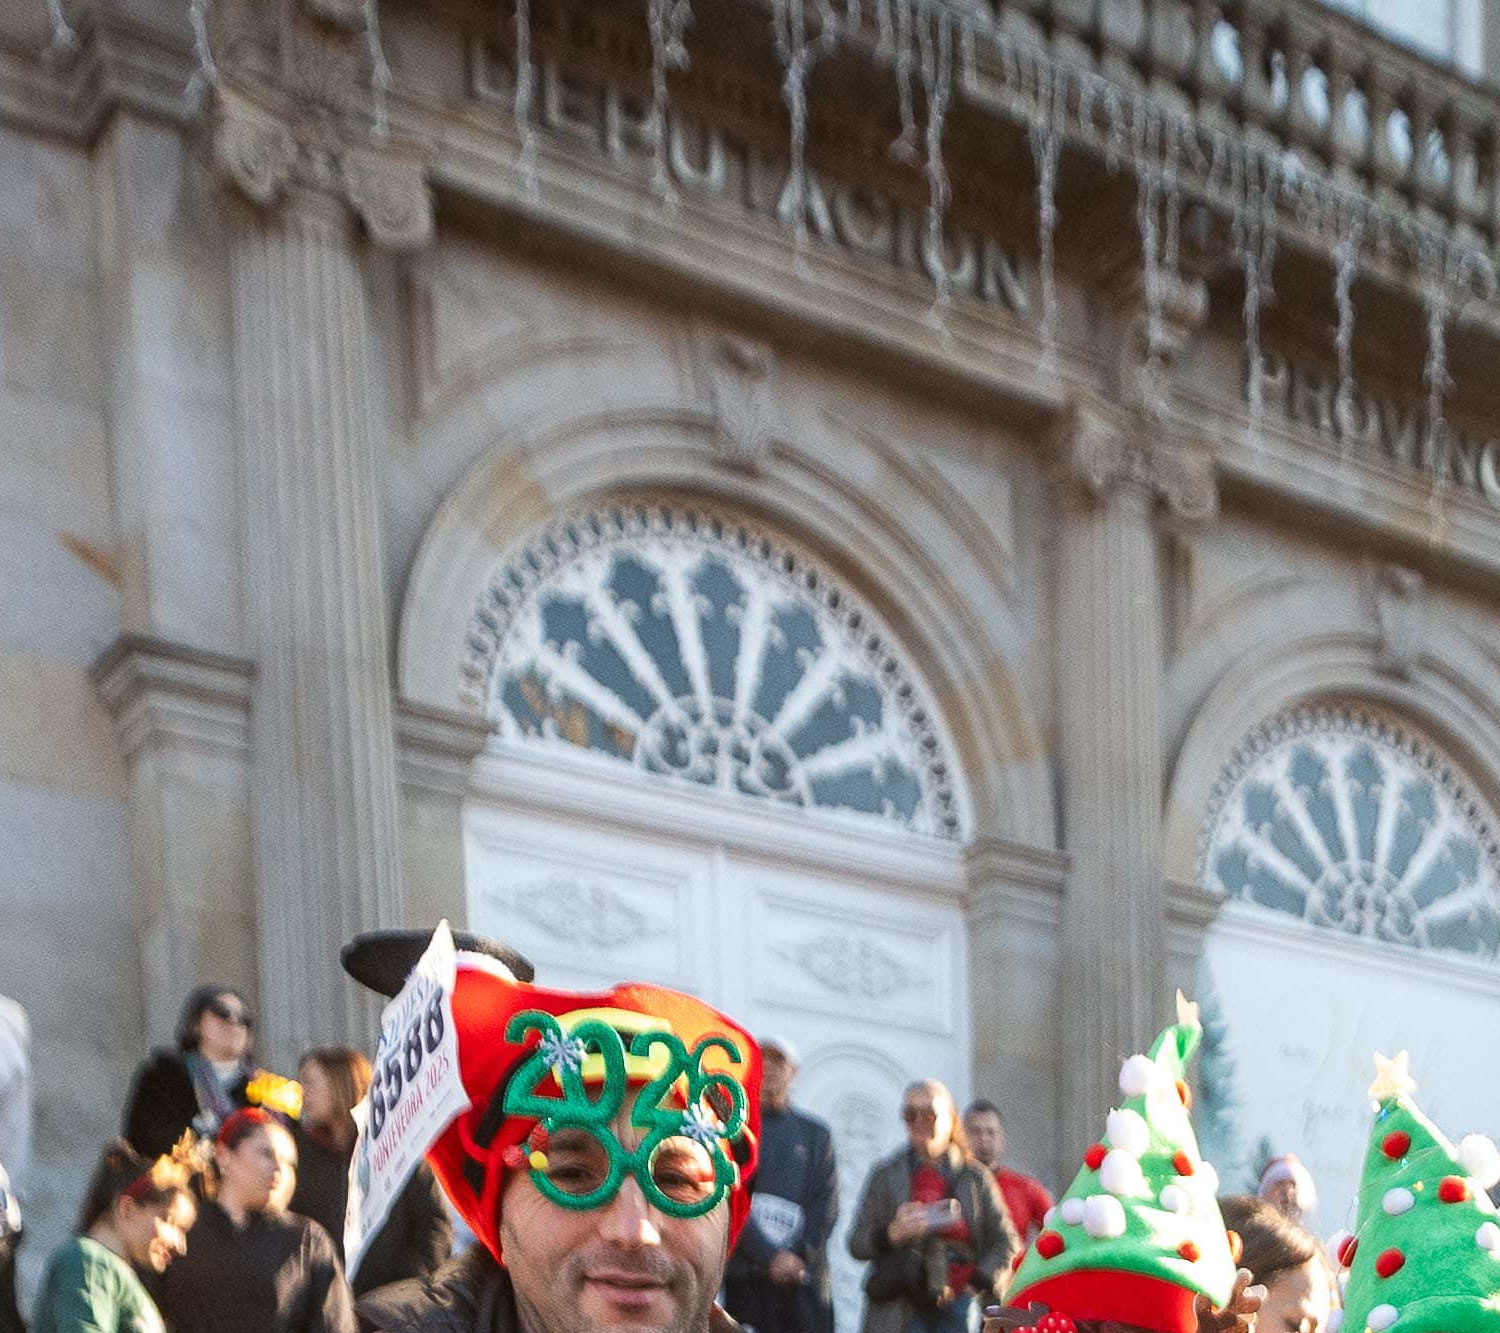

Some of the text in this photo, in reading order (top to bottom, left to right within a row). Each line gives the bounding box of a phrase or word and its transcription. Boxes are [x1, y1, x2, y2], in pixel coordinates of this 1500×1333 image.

[372, 1083, 424, 1178] PONTEVEDRA
[425, 1052, 451, 1097] 2025
[503, 1009, 748, 1139] 2026
